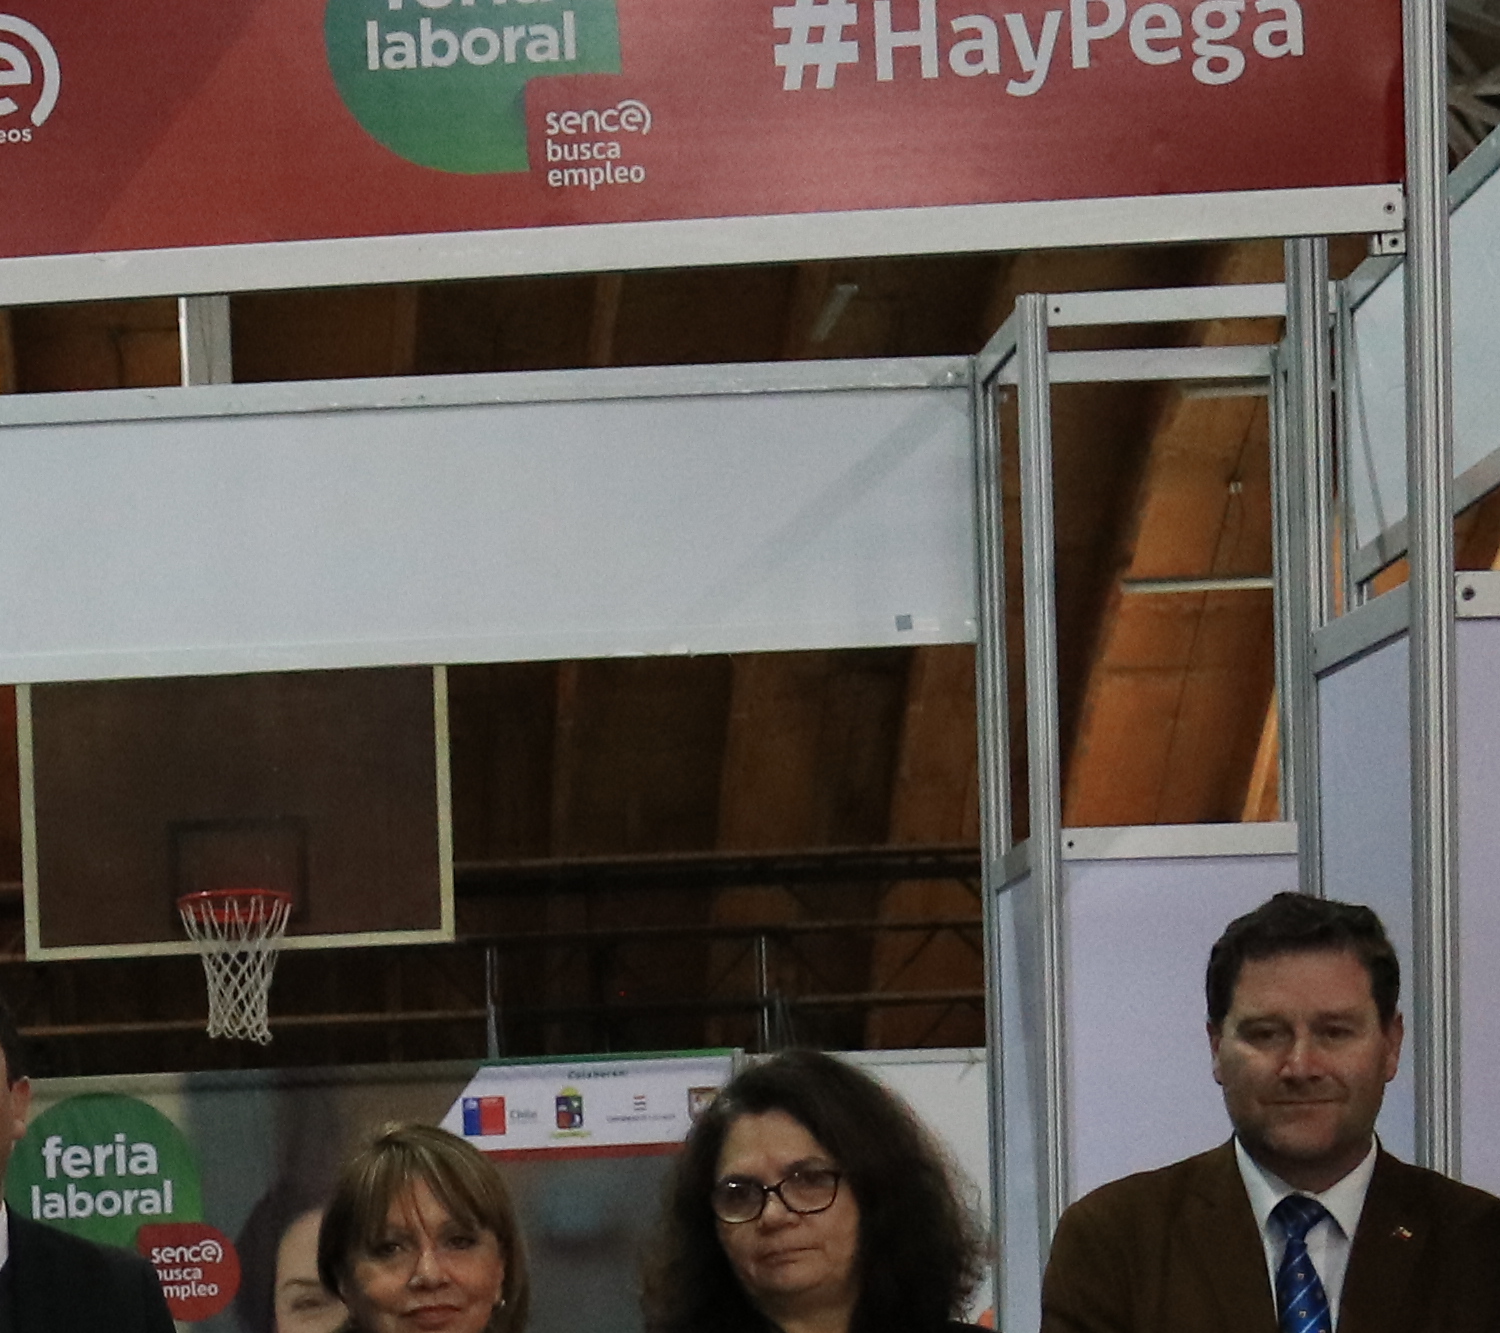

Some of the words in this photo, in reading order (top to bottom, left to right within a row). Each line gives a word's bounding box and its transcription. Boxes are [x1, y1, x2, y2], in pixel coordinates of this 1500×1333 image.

[366, 10, 577, 71] laboral
[772, 0, 1305, 97] #HayPega
[545, 99, 652, 135] sence
[545, 138, 621, 162] busca
[547, 161, 647, 191] empleo
[41, 1133, 158, 1179] feria
[30, 1179, 174, 1220] laboral
[151, 1238, 224, 1264] sence
[162, 1281, 219, 1301] mpleo
